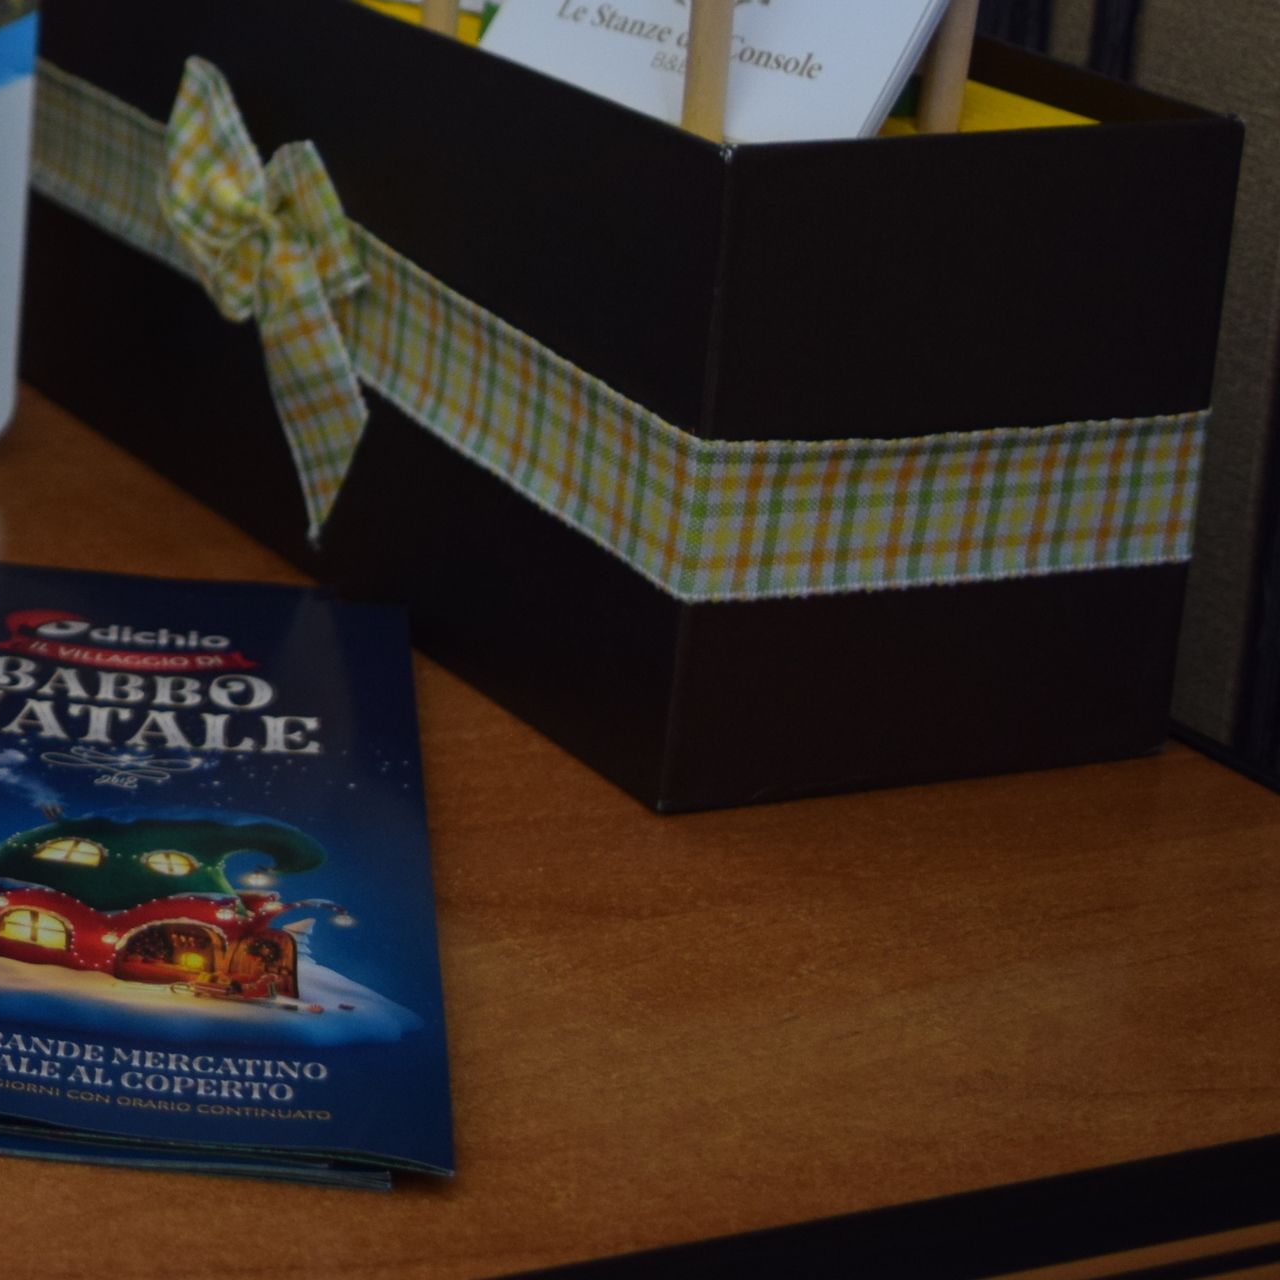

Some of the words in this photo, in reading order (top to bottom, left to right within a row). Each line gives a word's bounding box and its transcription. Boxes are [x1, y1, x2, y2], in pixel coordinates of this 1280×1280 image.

[590, 3, 672, 43] Stanze
[90, 624, 231, 649] dichio
[28, 640, 49, 653] IL
[57, 645, 189, 668] VILLAGGIO
[194, 655, 224, 668] DI
[111, 1047, 329, 1081] MERCATINO
[67, 1065, 113, 1087] AL
[120, 1071, 294, 1102] COPERTO
[66, 1088, 111, 1105] CON
[116, 1096, 191, 1113] ORARIO
[197, 1103, 332, 1121] CONTINUATO
